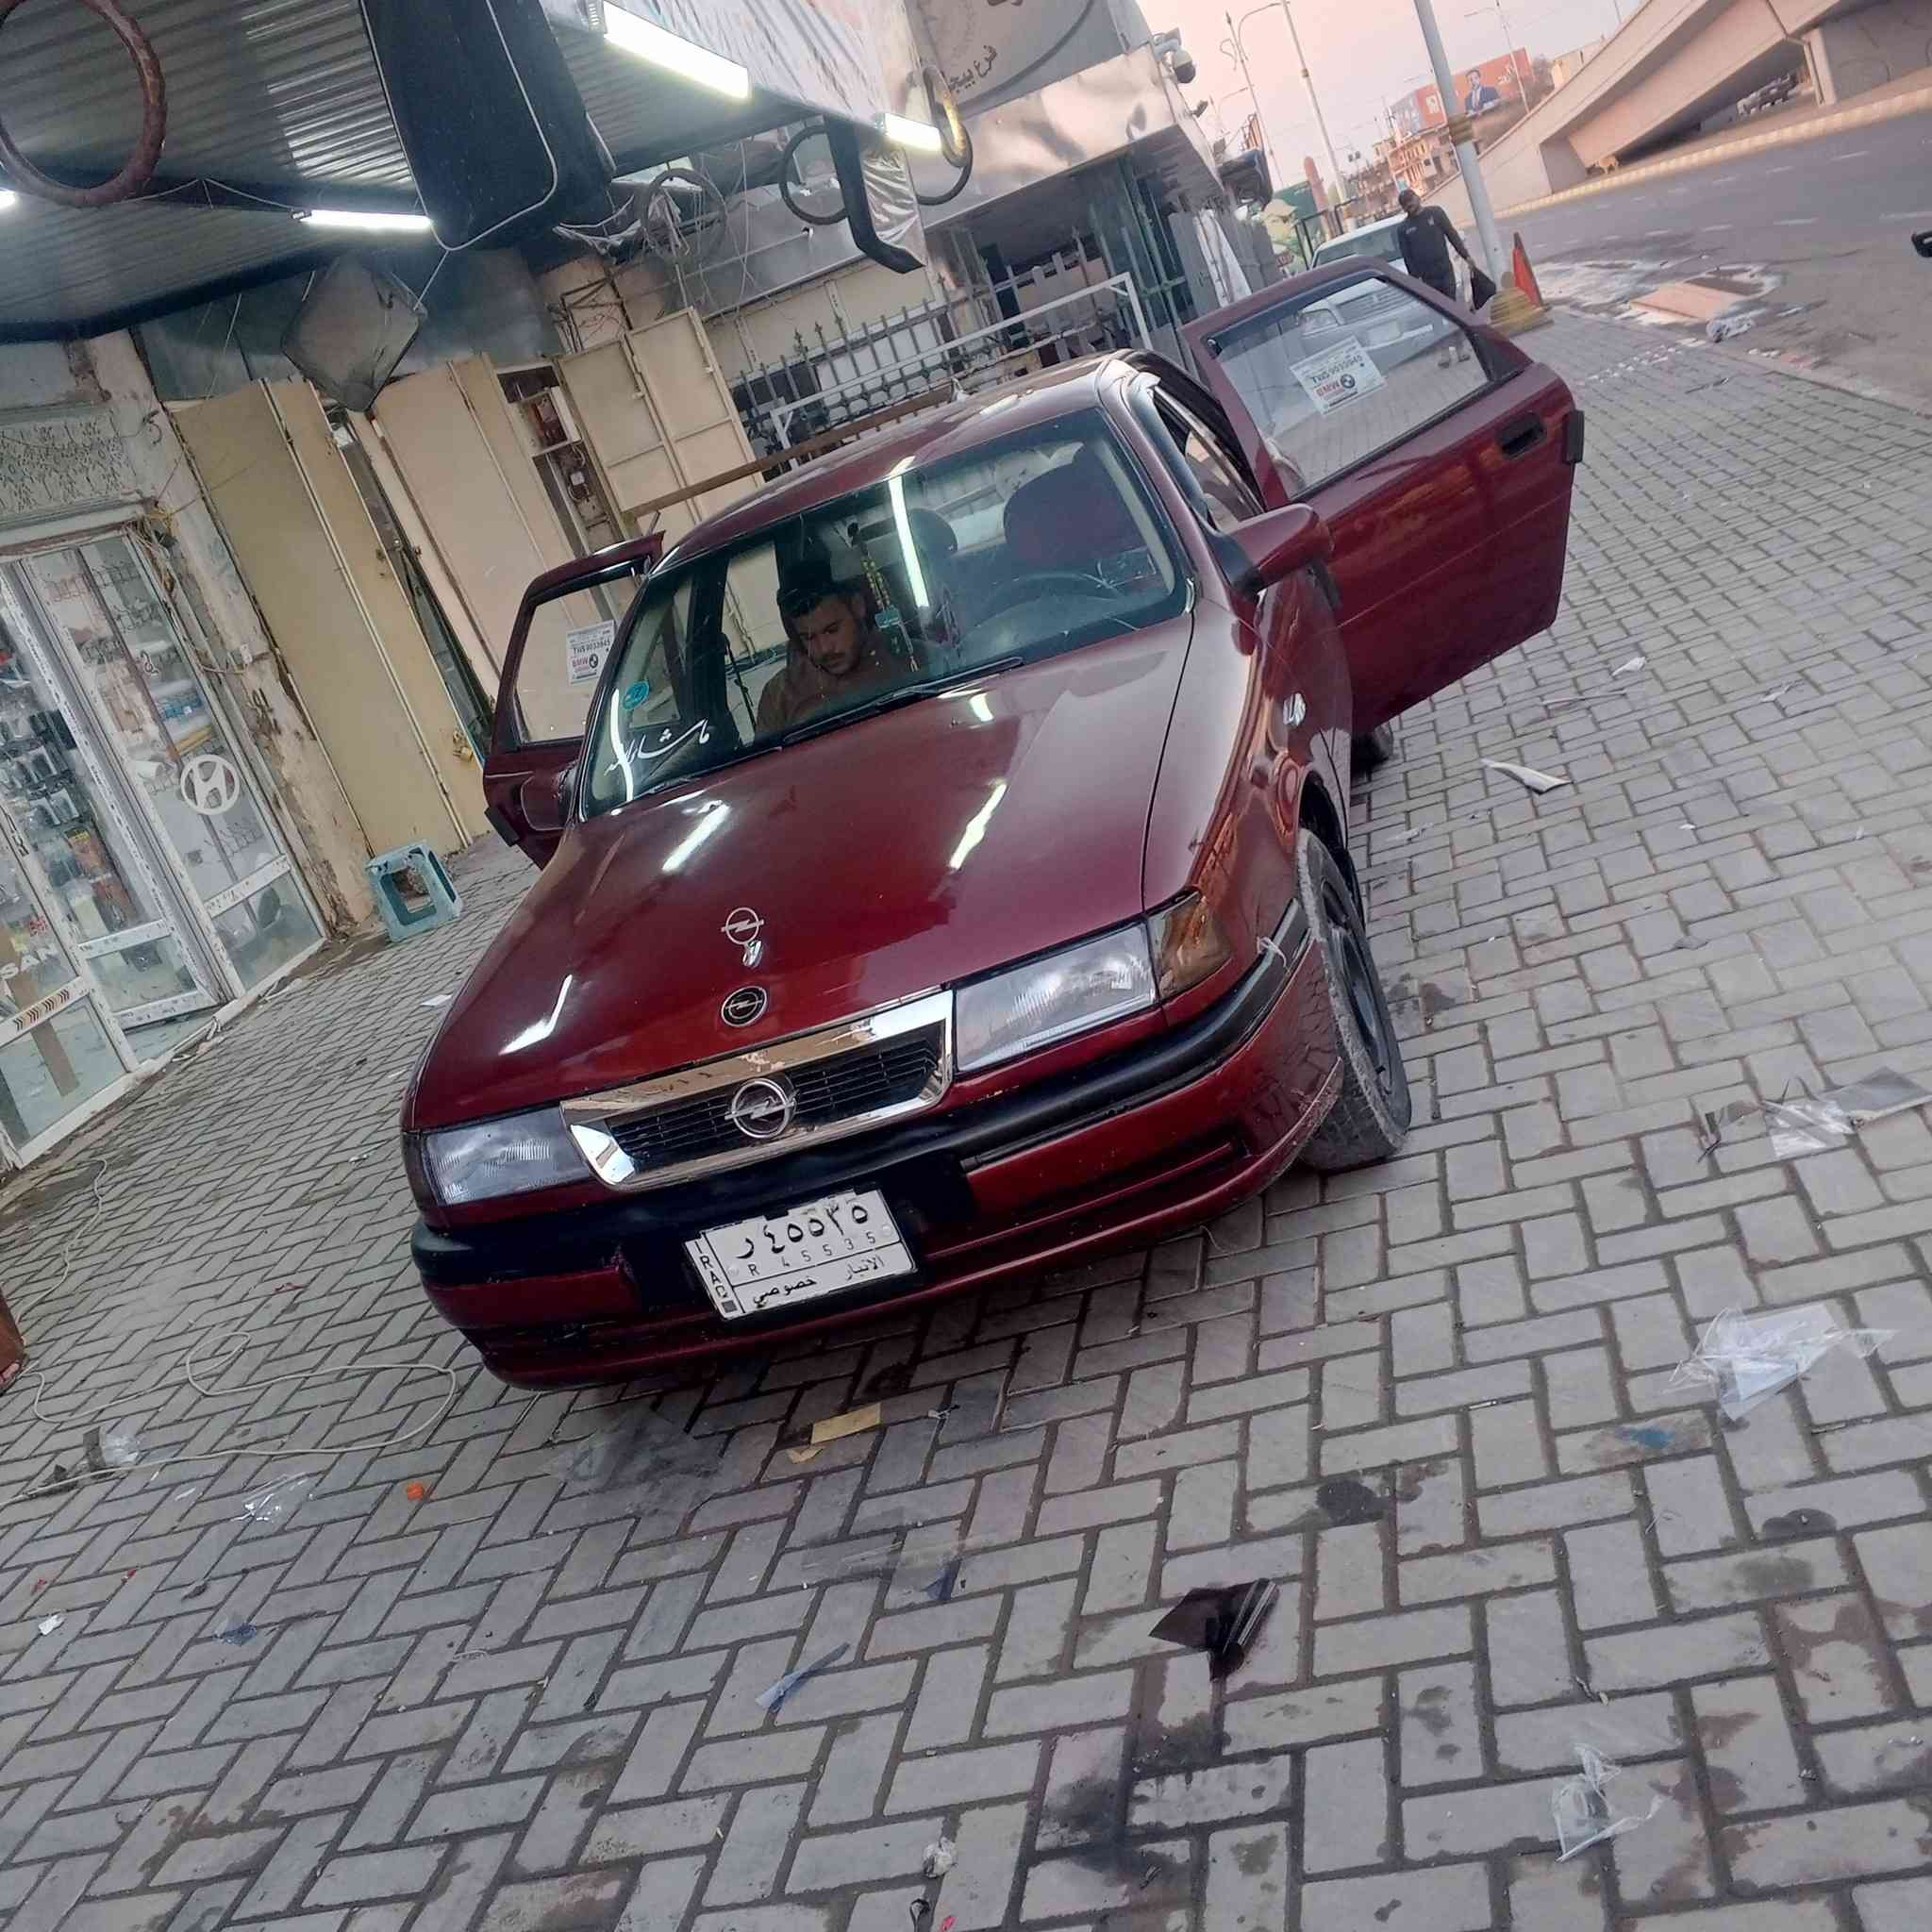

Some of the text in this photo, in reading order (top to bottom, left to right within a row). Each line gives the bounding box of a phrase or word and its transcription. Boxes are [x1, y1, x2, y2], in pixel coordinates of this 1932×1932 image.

[949, 44, 997, 93] فرع بيج
[572, 656, 589, 668] BMW
[693, 1240, 729, 1299] IRAQ
[748, 1230, 877, 1276] R 45535
[753, 1275, 818, 1309] خصوصي
